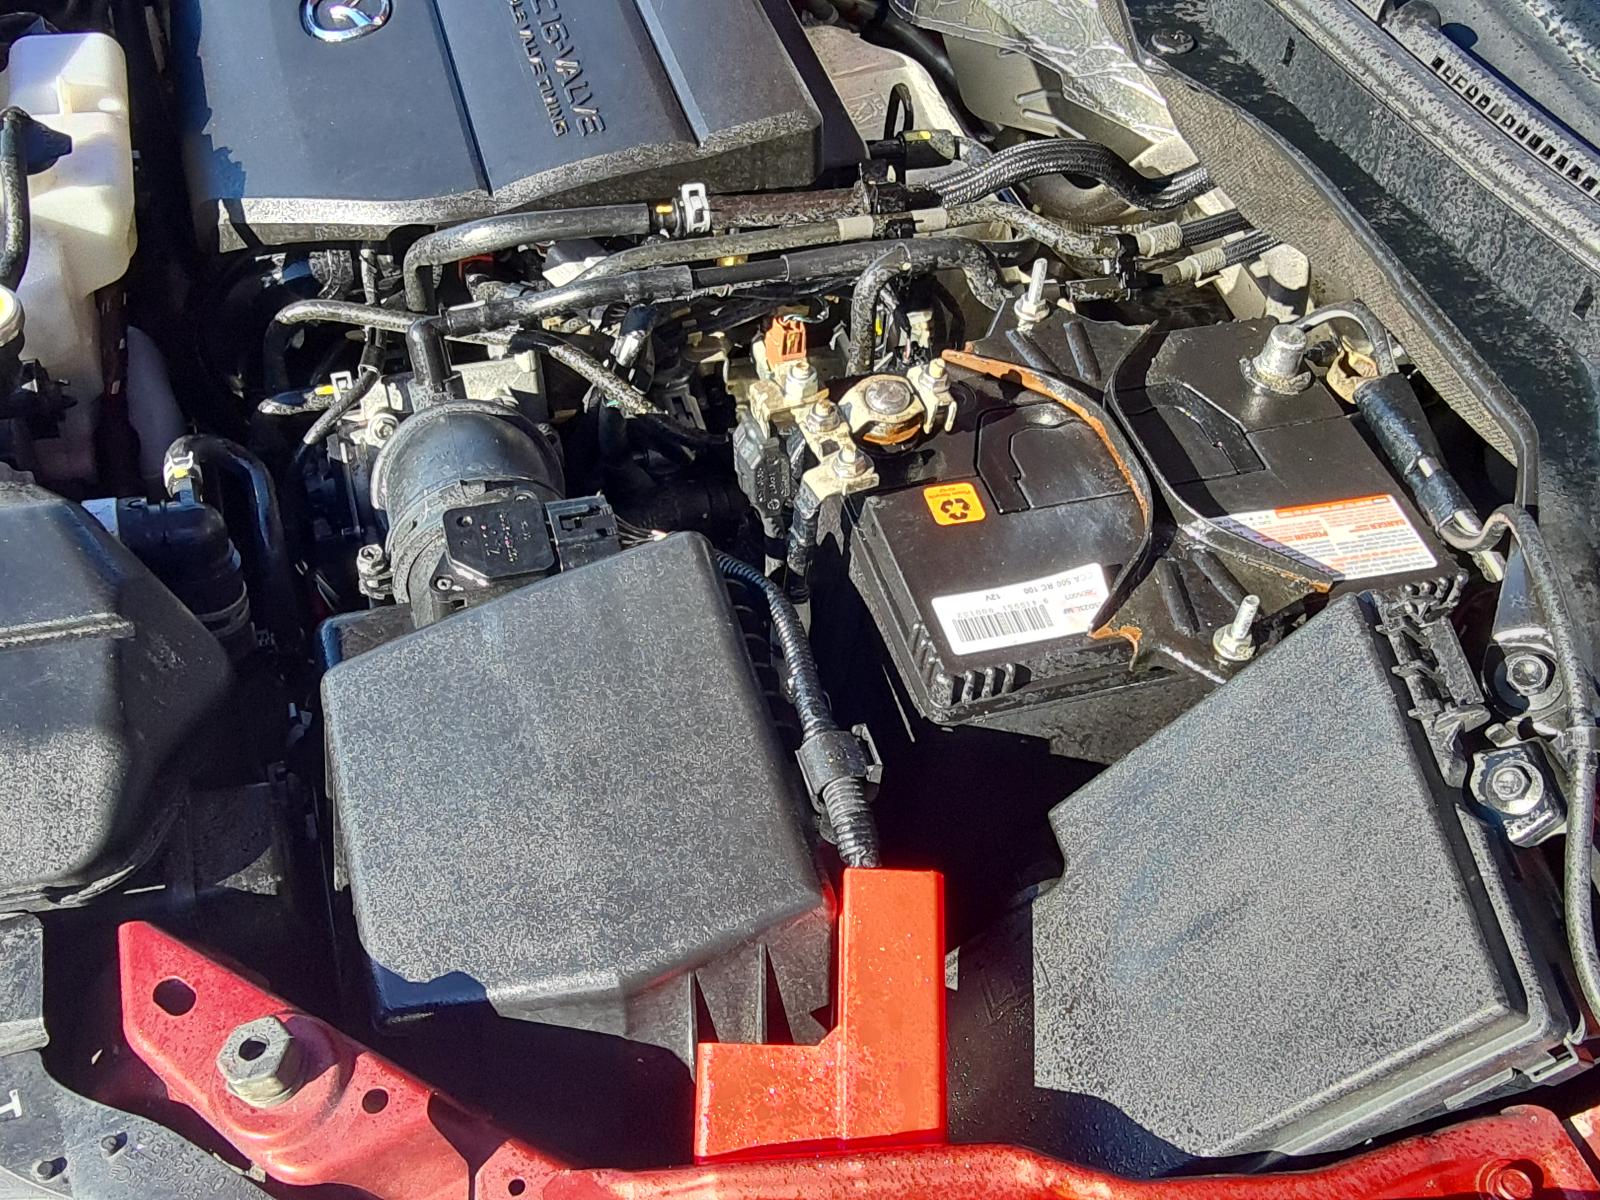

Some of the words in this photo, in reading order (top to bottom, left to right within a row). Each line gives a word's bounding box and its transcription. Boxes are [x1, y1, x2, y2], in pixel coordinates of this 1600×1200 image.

[538, 12, 606, 137] 16-VALVE
[518, 23, 547, 76] VALVE
[536, 74, 571, 137] TIMING
[1040, 582, 1054, 592] RC
[1056, 577, 1072, 588] 500
[1023, 586, 1038, 594] 100
[985, 593, 1001, 601] 12V
